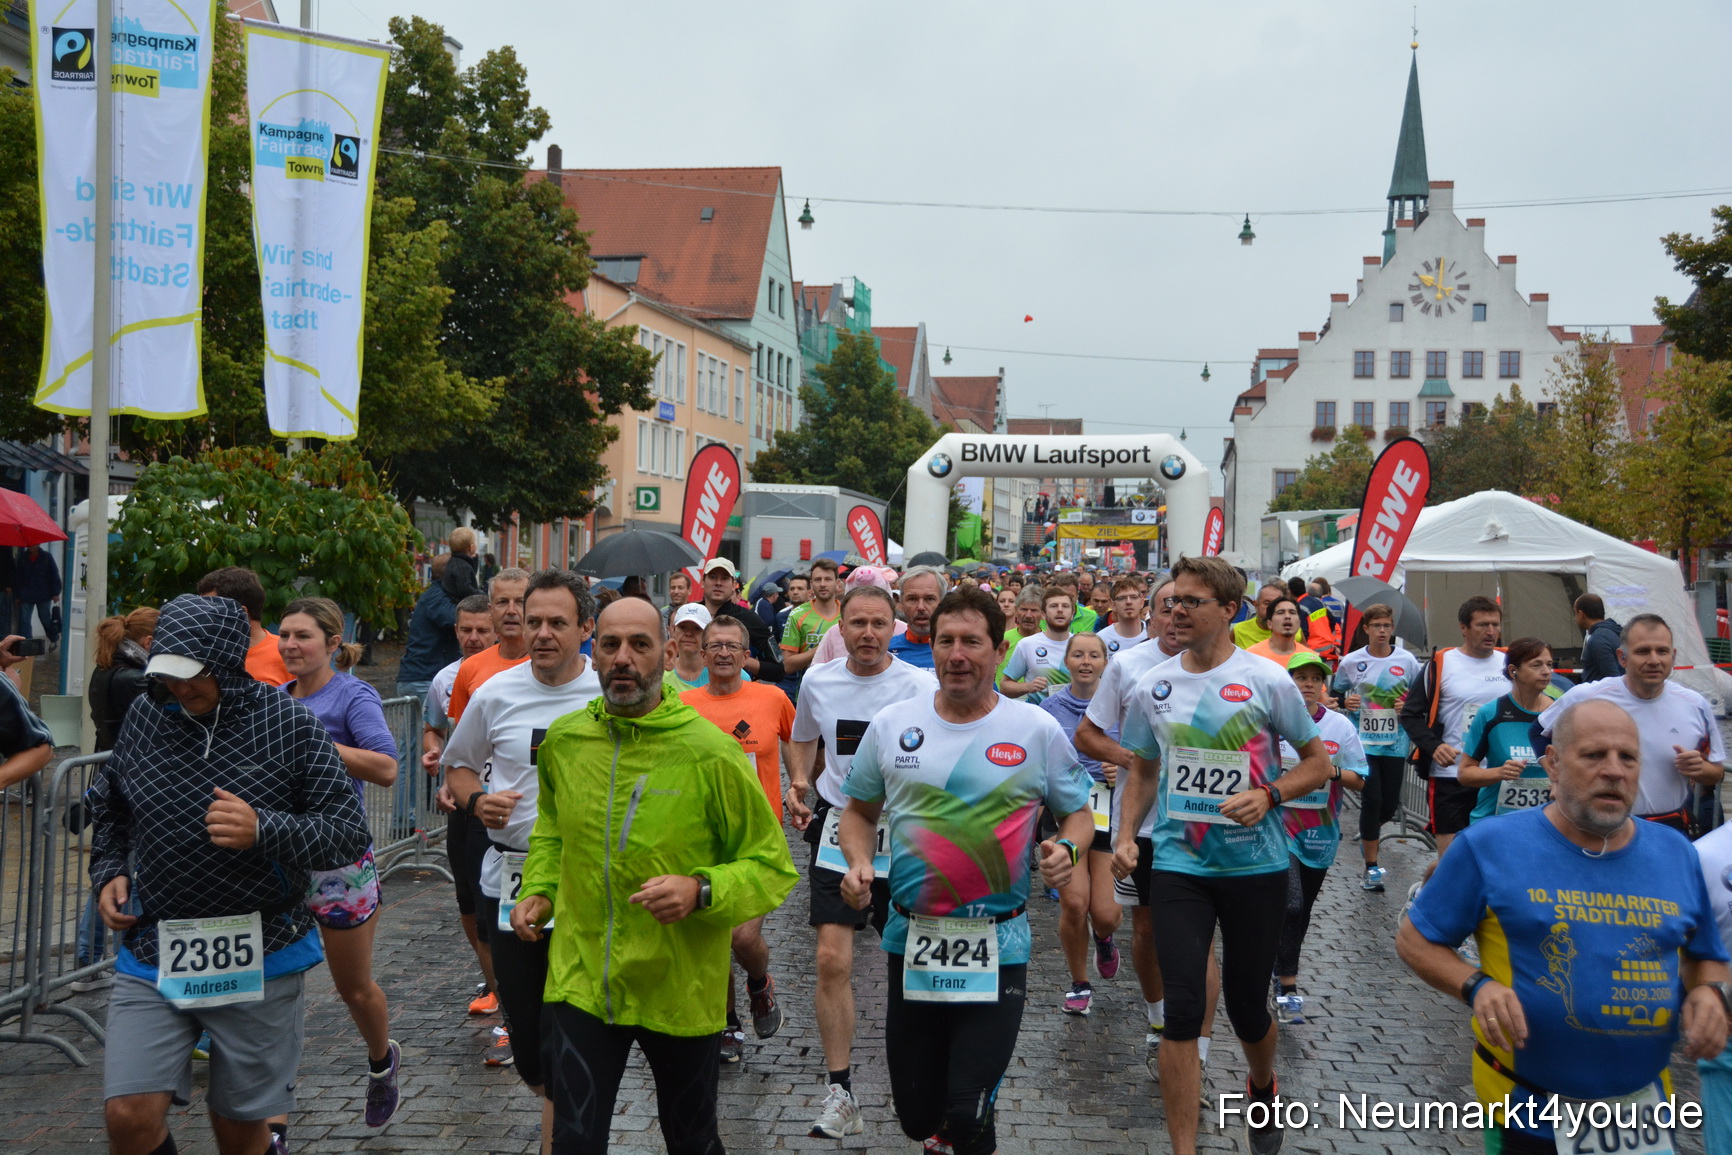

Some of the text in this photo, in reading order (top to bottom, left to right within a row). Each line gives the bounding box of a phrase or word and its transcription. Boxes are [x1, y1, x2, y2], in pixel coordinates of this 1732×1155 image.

[259, 123, 324, 143] Kampagne
[260, 136, 328, 159] Fairtrade
[287, 161, 324, 175] Towns
[331, 168, 357, 178] FAIRTRADE
[262, 243, 332, 271] Wir sind
[268, 309, 318, 330] tadt
[961, 442, 1151, 468] BMW Laufsport
[639, 489, 657, 508] D
[1357, 459, 1420, 578] REWE
[1097, 527, 1119, 537] ZIEL
[1206, 515, 1222, 557] EWE
[1224, 688, 1249, 697] Hervis
[1363, 718, 1395, 731] 3079
[991, 748, 1022, 760] Hervis
[1203, 751, 1243, 763] BOCK
[1175, 764, 1242, 796] 2422
[1184, 799, 1221, 813] Andrea
[1307, 829, 1319, 839] 17.
[966, 903, 988, 918] 17.
[1526, 888, 1679, 916] 10. NEUMARKTER
[1554, 905, 1662, 928] STADTLAUF
[170, 933, 254, 972] 2385
[912, 935, 990, 968] 2424
[183, 979, 238, 995] Andreas
[932, 975, 966, 989] Franz
[1611, 986, 1672, 1001] 20.09.2009
